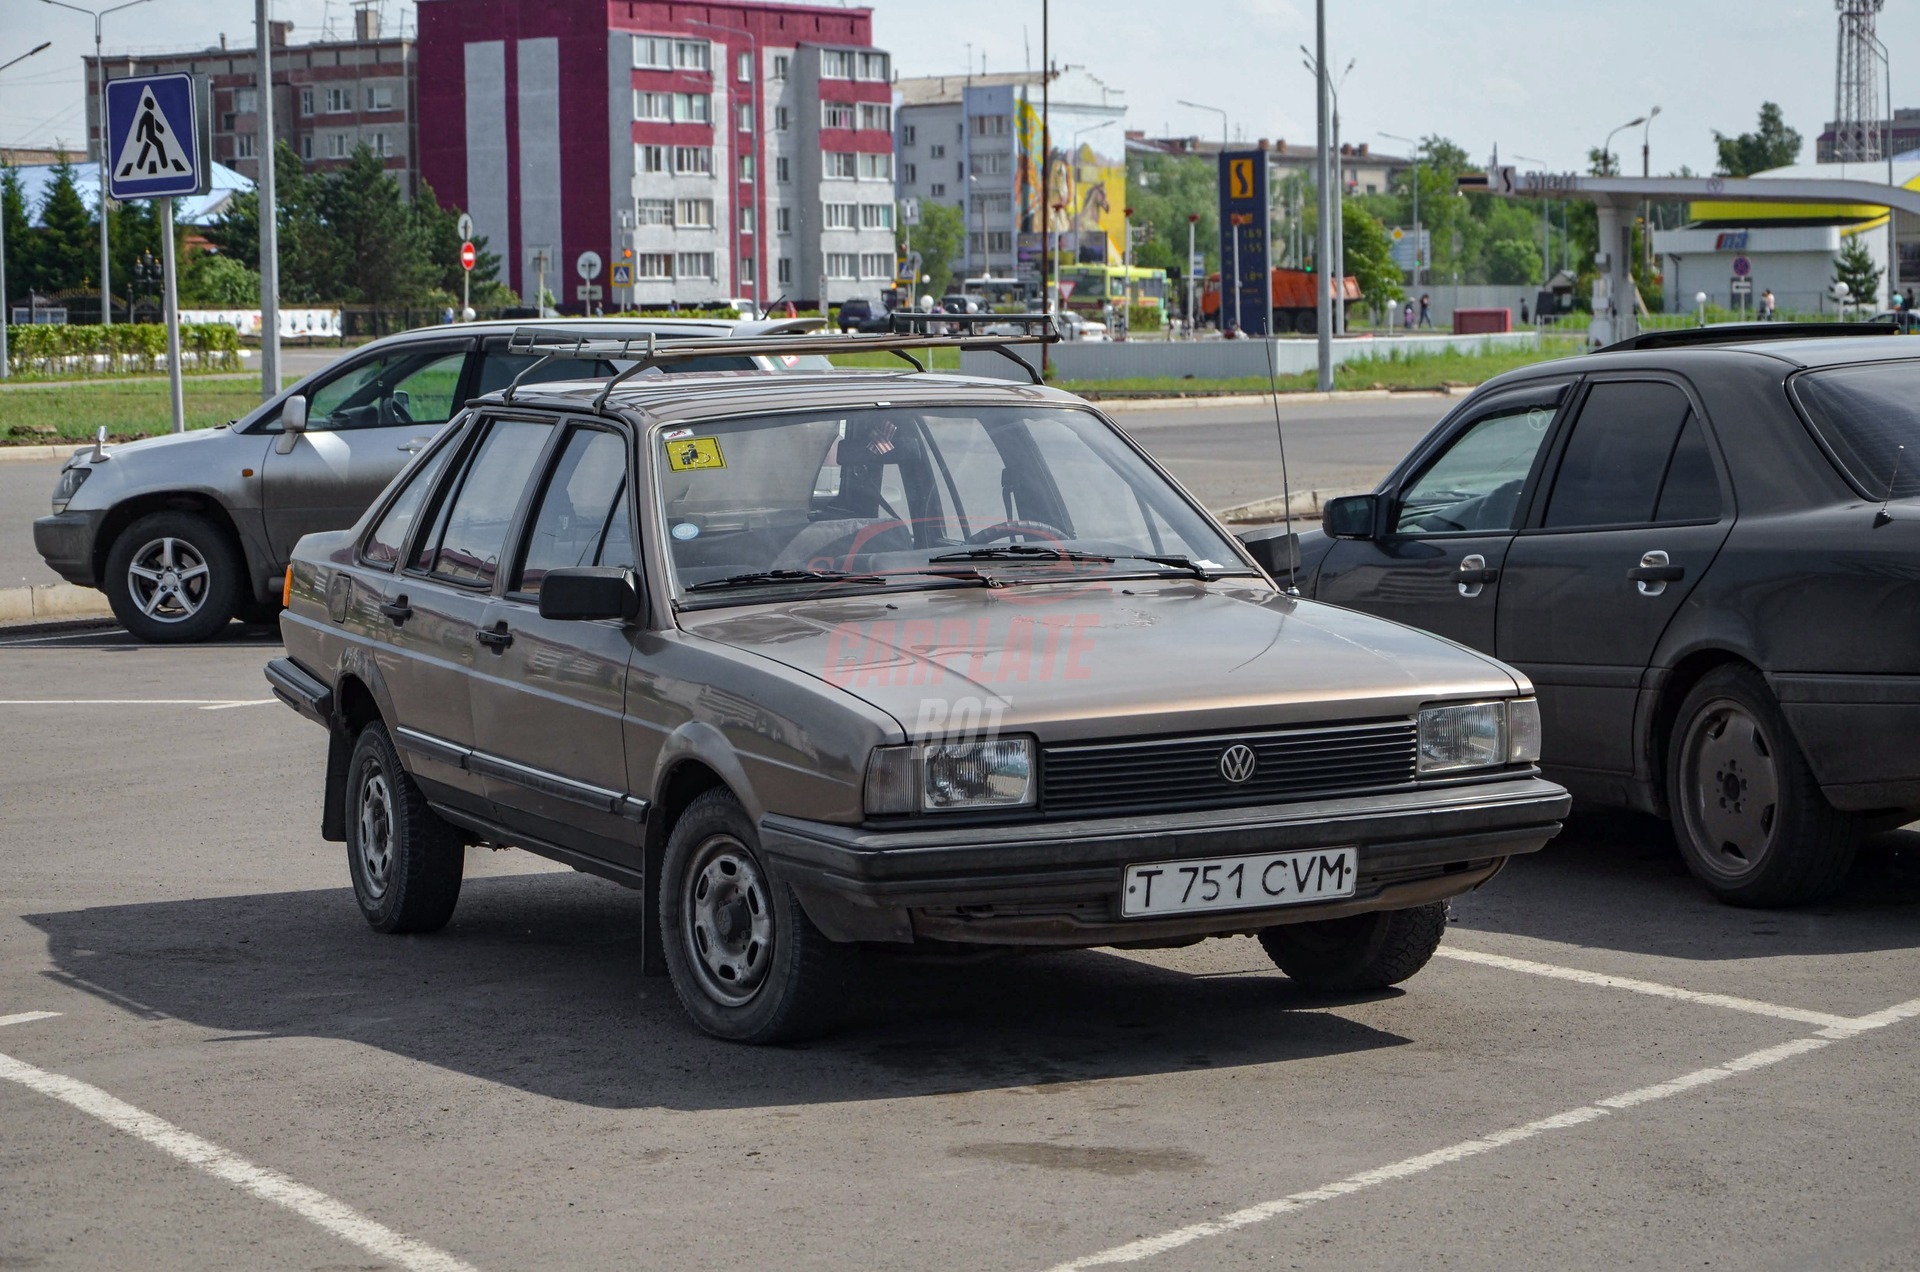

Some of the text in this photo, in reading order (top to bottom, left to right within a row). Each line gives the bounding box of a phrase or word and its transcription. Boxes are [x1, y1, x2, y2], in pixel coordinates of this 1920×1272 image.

[1136, 853, 1346, 907] T 751 CVM
